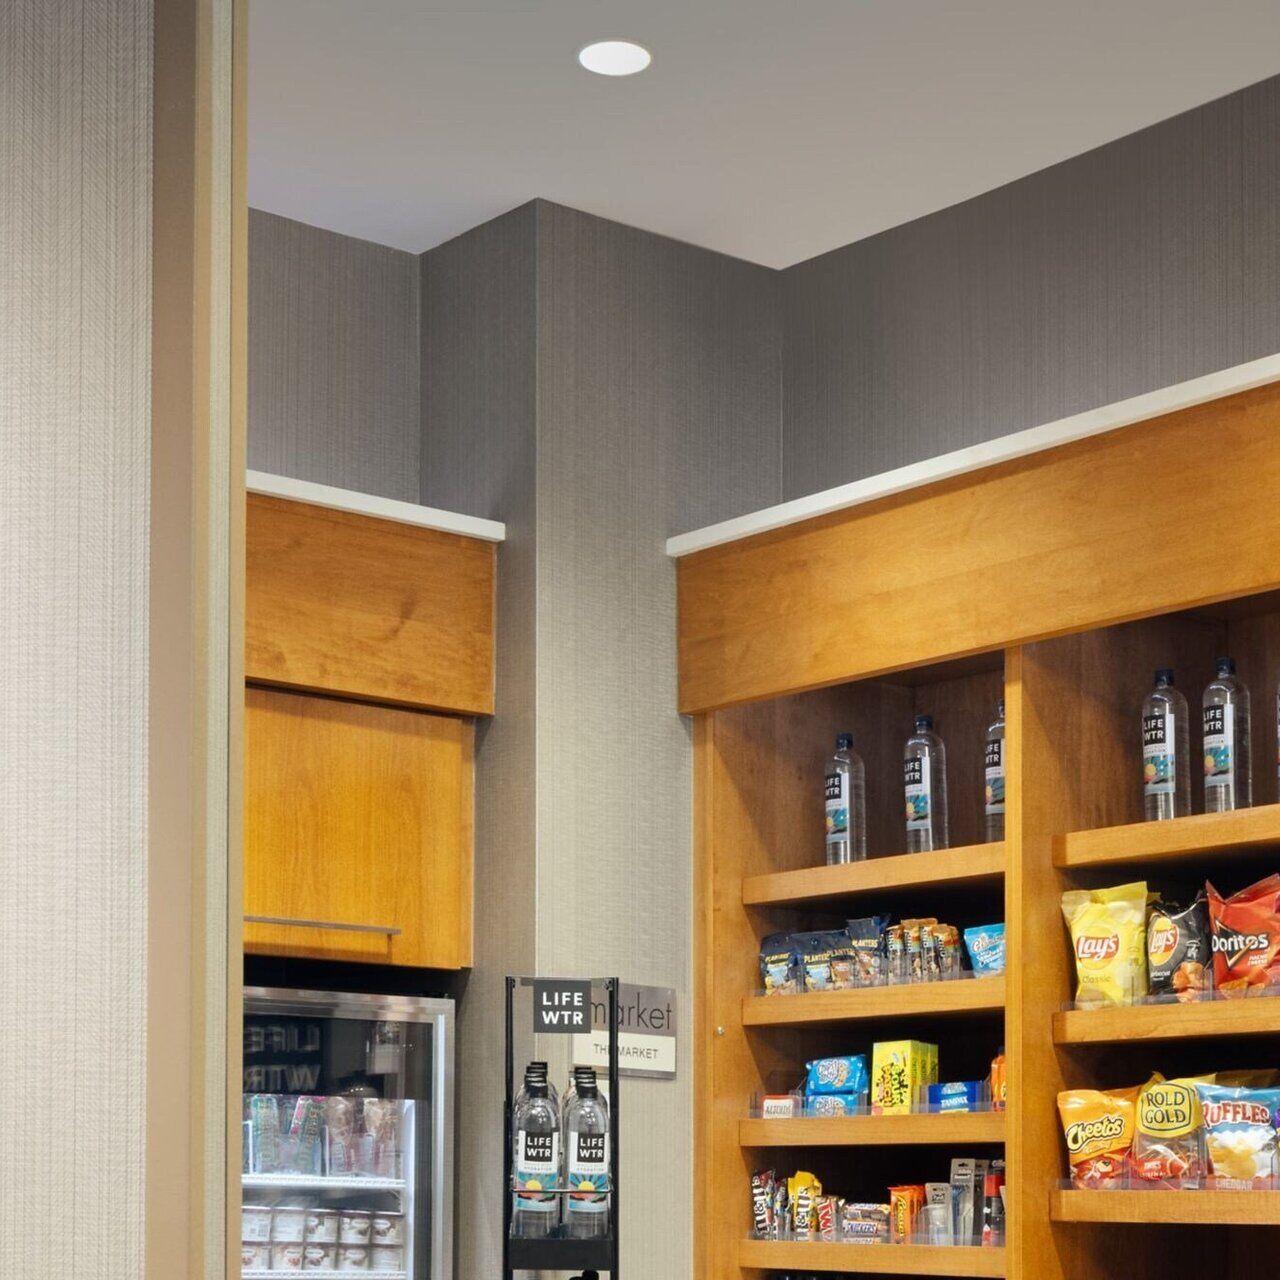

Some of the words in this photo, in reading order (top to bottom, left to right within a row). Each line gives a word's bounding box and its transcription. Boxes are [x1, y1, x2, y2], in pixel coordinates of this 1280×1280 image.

[1204, 710, 1221, 721] LIFE
[1144, 719, 1163, 730] LIFE
[1145, 730, 1164, 740] WTR
[1077, 934, 1118, 960] Lay's
[1211, 933, 1269, 952] Doritos
[542, 992, 583, 1006] LIFE
[541, 1011, 584, 1025] WTR
[618, 1046, 659, 1059] MARKET
[1146, 1091, 1185, 1108] ROLD
[1145, 1109, 1186, 1124] GOLD
[1203, 1102, 1271, 1128] RUFFLES
[1067, 1116, 1123, 1152] Cheetos
[527, 1136, 552, 1147] LIFE
[580, 1137, 604, 1147] LIFE
[526, 1147, 551, 1158] WTR
[579, 1148, 603, 1158] WTR
